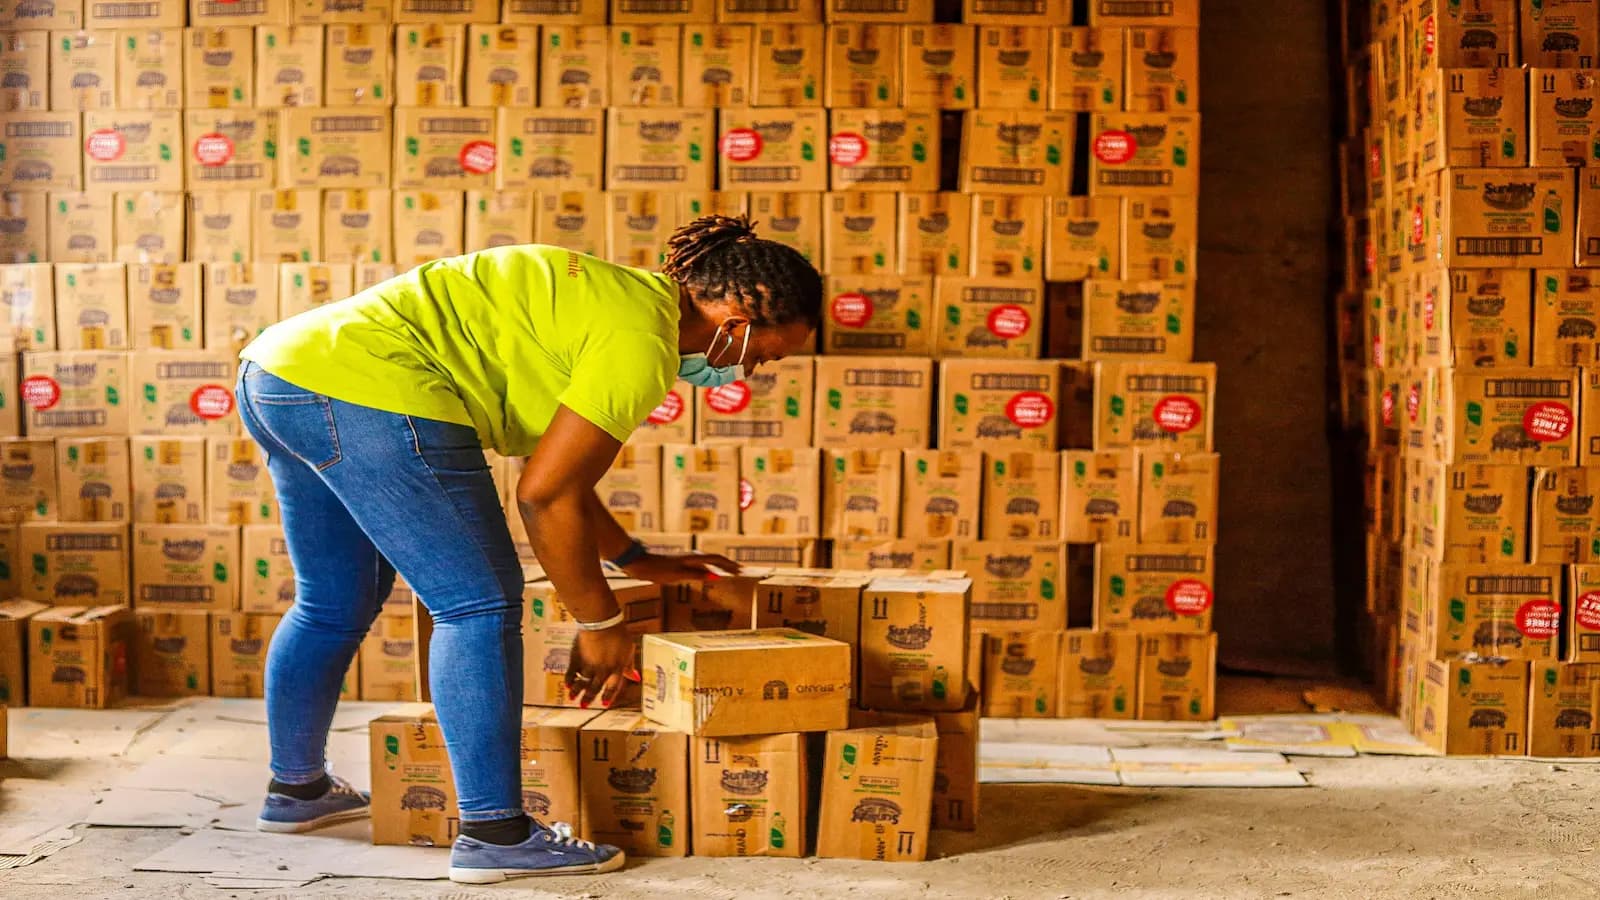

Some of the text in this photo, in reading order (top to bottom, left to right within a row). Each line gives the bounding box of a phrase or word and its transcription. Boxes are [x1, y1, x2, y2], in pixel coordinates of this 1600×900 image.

[1484, 182, 1537, 194] Sunlight
[796, 685, 834, 694] BRAND
[722, 769, 769, 782] Sunlight
[401, 798, 448, 811] Sunlight
[852, 810, 903, 825] Sunlight
